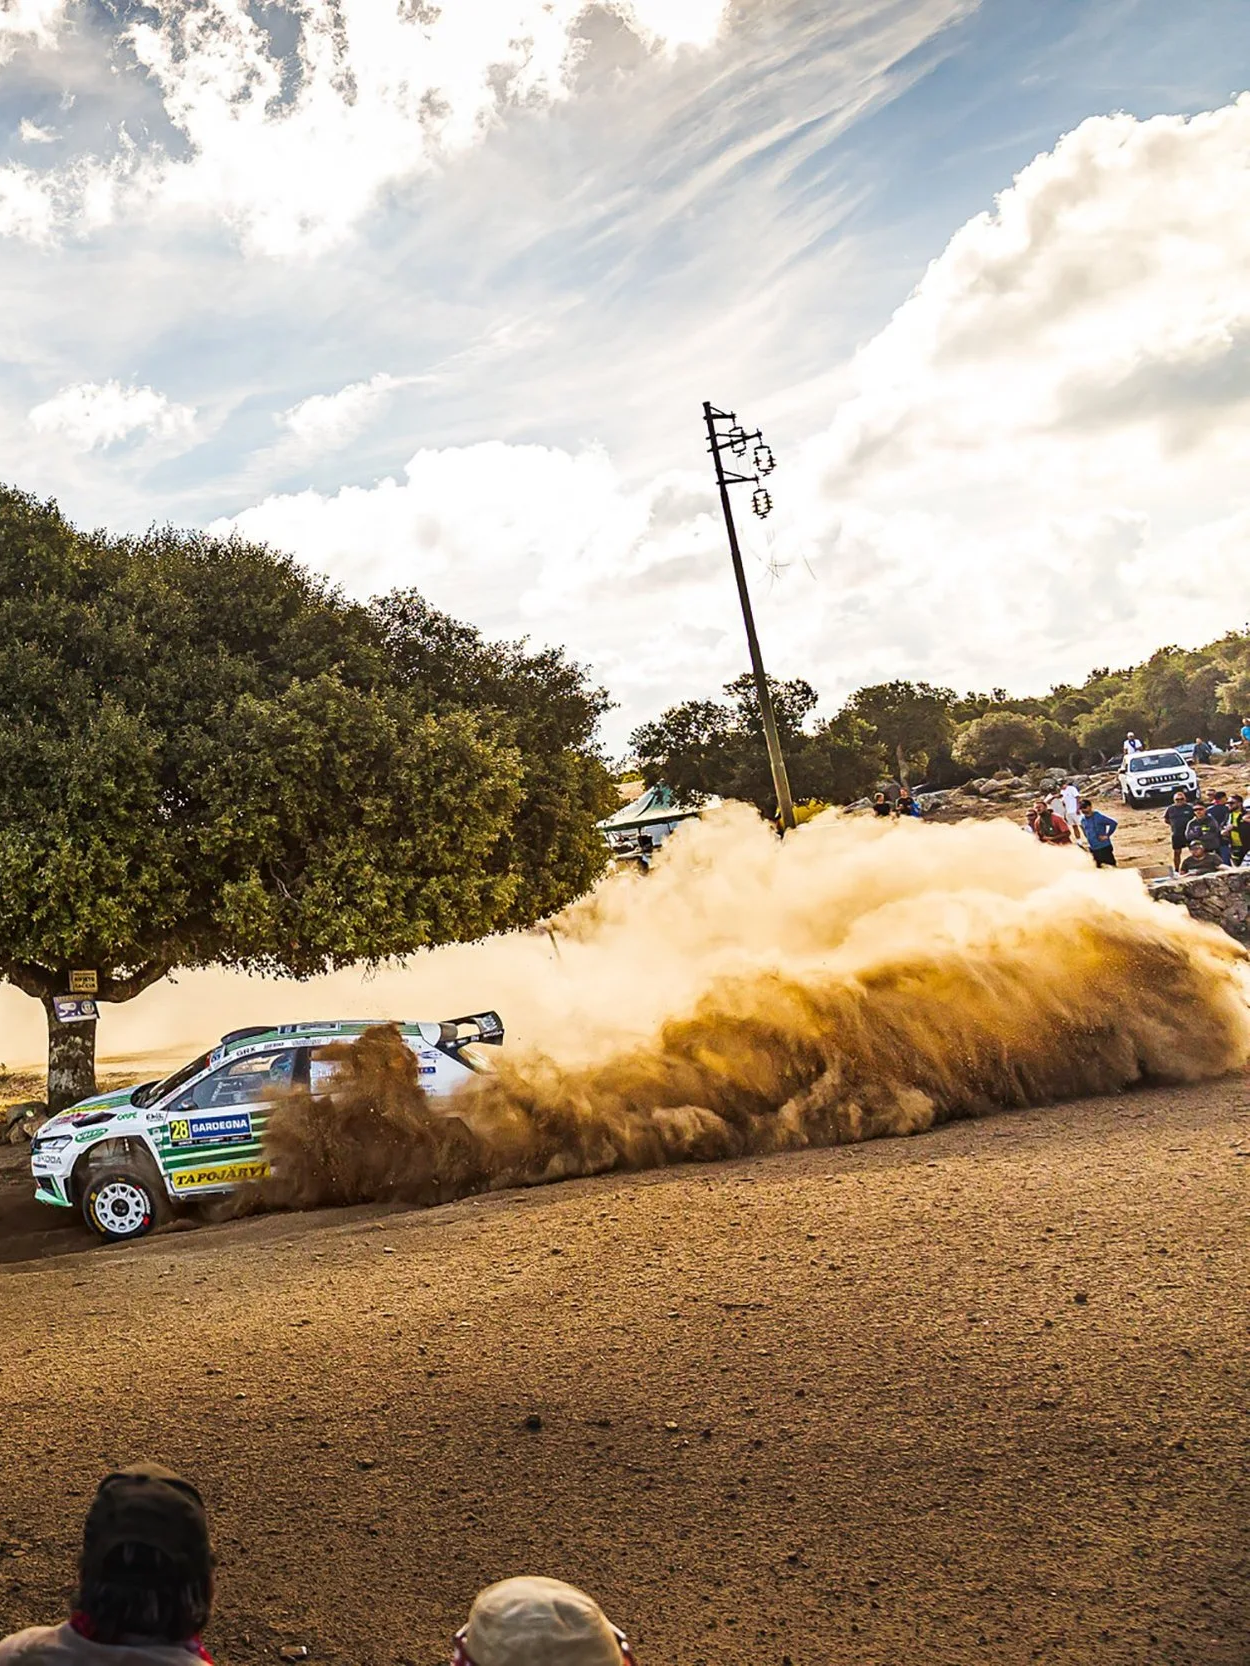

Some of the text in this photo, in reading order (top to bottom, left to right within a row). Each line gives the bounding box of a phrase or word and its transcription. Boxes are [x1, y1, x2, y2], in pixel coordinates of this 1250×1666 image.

[236, 1047, 256, 1056] GRX
[171, 1120, 189, 1140] 28
[191, 1119, 248, 1133] SARDEGNA
[176, 1164, 268, 1186] TAPOJÄRVI
